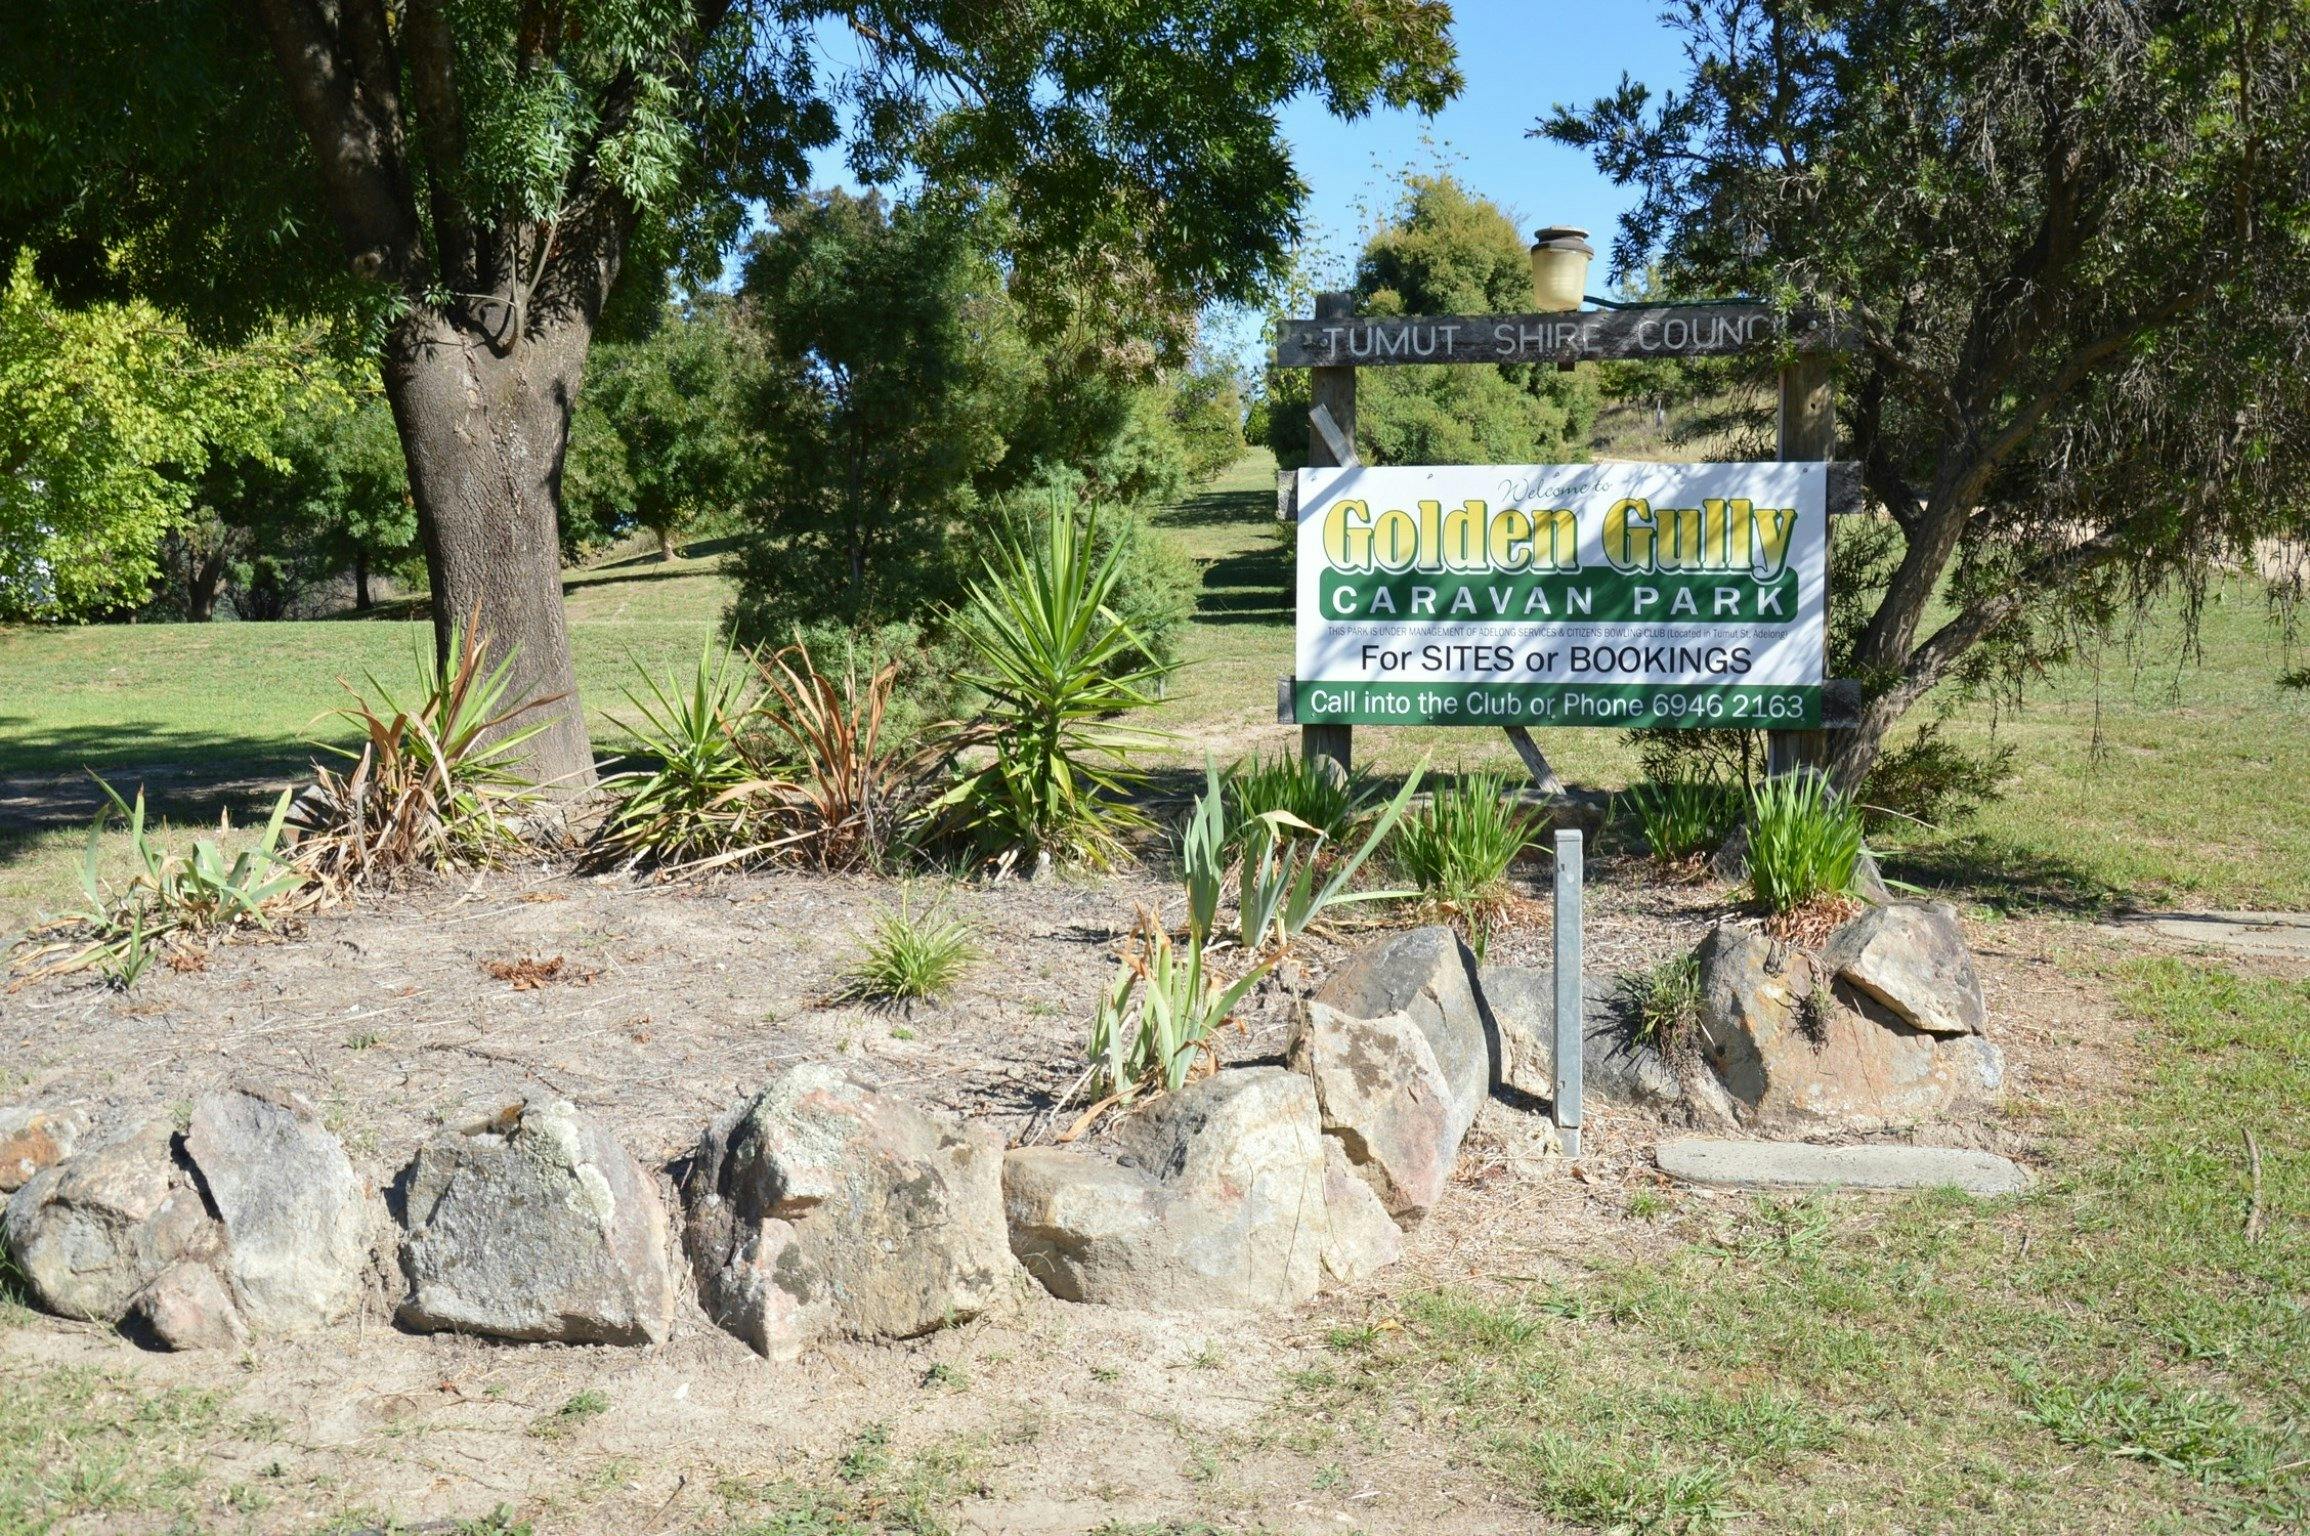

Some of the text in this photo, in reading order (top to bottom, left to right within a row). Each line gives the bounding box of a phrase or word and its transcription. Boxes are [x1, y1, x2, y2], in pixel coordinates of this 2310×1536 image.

[1322, 324, 1461, 357] TUMUT
[1493, 322, 1603, 355] SHIRE
[1498, 478, 1613, 502] Welcome to
[1323, 498, 1796, 582] Golden Gully
[1332, 586, 1785, 616] CARAVAN PARK
[1328, 626, 1345, 636] THIS
[1347, 626, 1369, 636] PARK
[1370, 627, 1377, 636] IS
[1379, 627, 1407, 636] UNDER
[1409, 627, 1464, 637] MANAGEMENT
[1466, 627, 1477, 636] OF
[1479, 627, 1517, 637] ADELONG
[1566, 628, 1602, 637] CITIZENS
[1604, 628, 1643, 638] BOWLING
[1644, 628, 1665, 638] CLUB
[1667, 628, 1702, 639] (Located
[1704, 629, 1711, 638] in
[1713, 629, 1738, 639] Tumut
[1753, 629, 1788, 640] Adelong)
[1361, 646, 1752, 674] For SITES or BOOKINGS
[1311, 690, 1803, 718] Call into the Club or Phone 6946 2163
